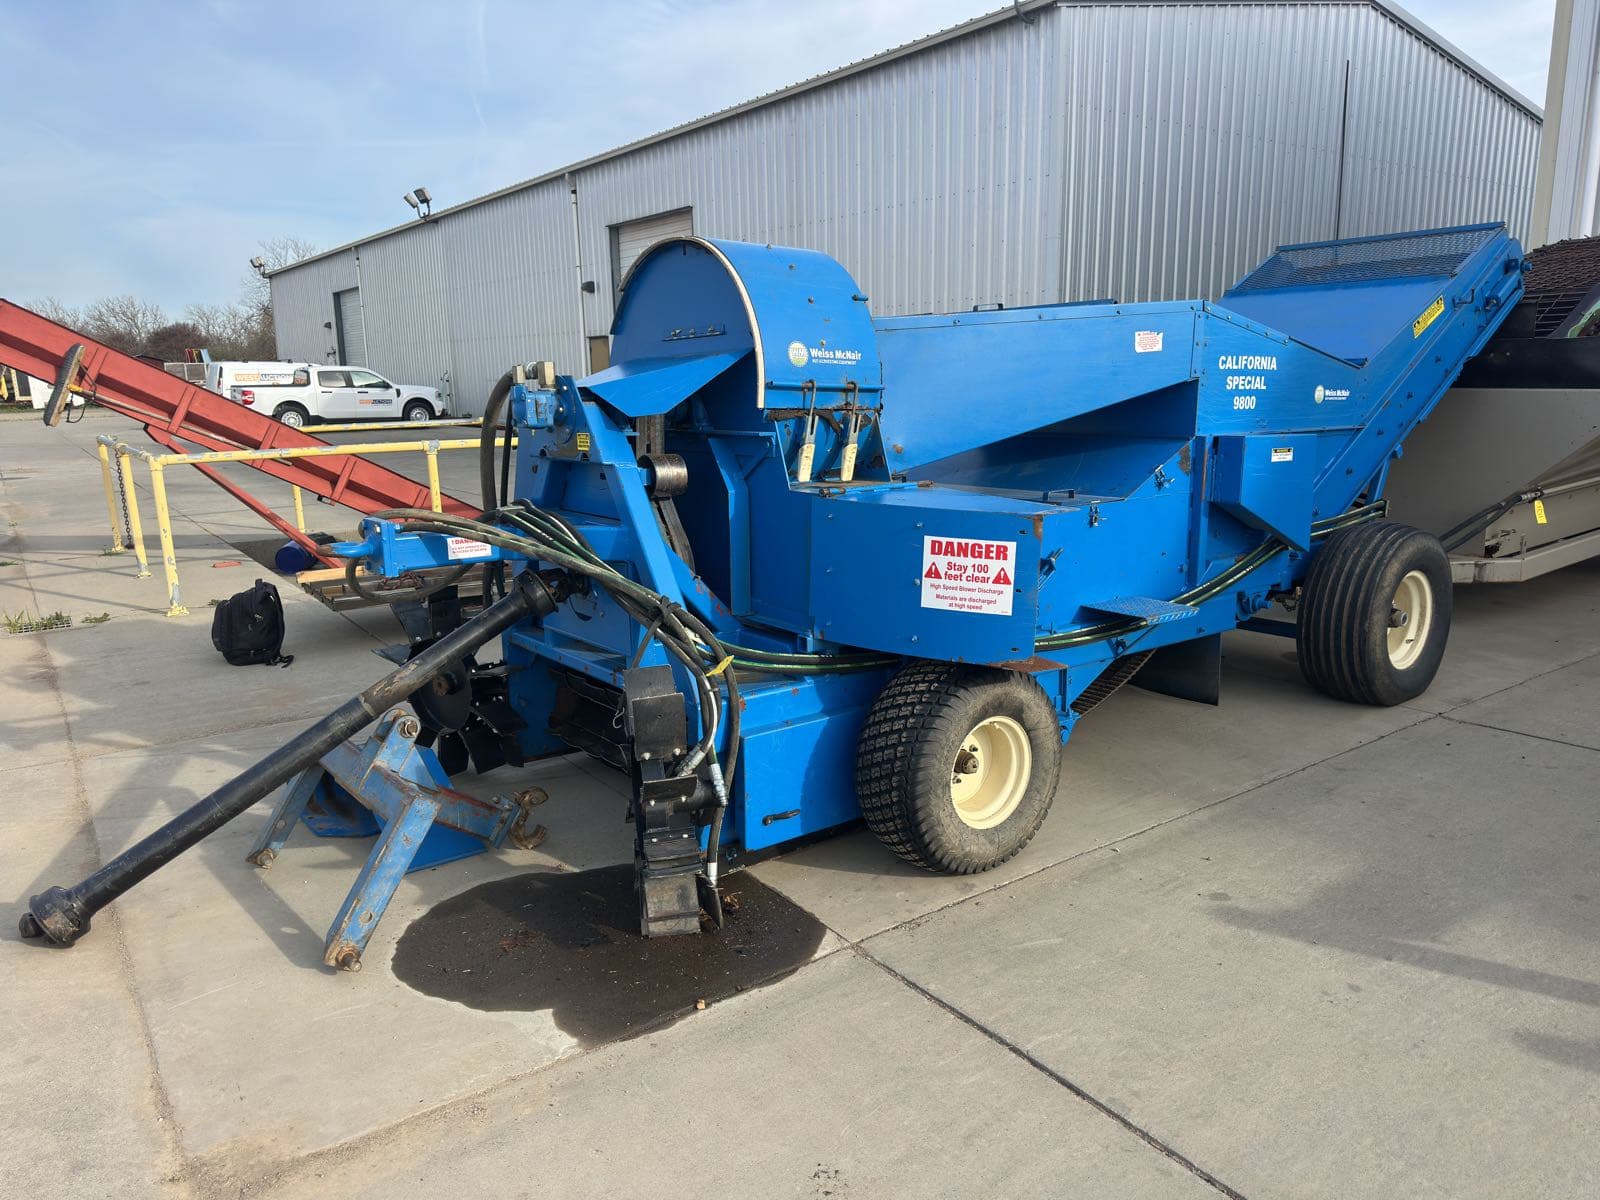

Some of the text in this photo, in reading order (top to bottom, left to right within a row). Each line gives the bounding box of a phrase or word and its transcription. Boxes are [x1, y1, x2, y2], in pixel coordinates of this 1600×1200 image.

[810, 348, 862, 360] Weiss McNair
[1218, 355, 1277, 370] CALIFORNIA
[1226, 375, 1267, 390] SPECIAL
[1233, 395, 1256, 410] 9800
[930, 540, 1008, 560] DANGER
[946, 561, 989, 574] Stay 100
[944, 571, 991, 584] feet clear
[942, 584, 958, 592] Speed
[958, 585, 976, 593] Blower
[977, 587, 1004, 596] Discharge
[936, 593, 958, 602] Materials
[968, 597, 996, 606] discharged
